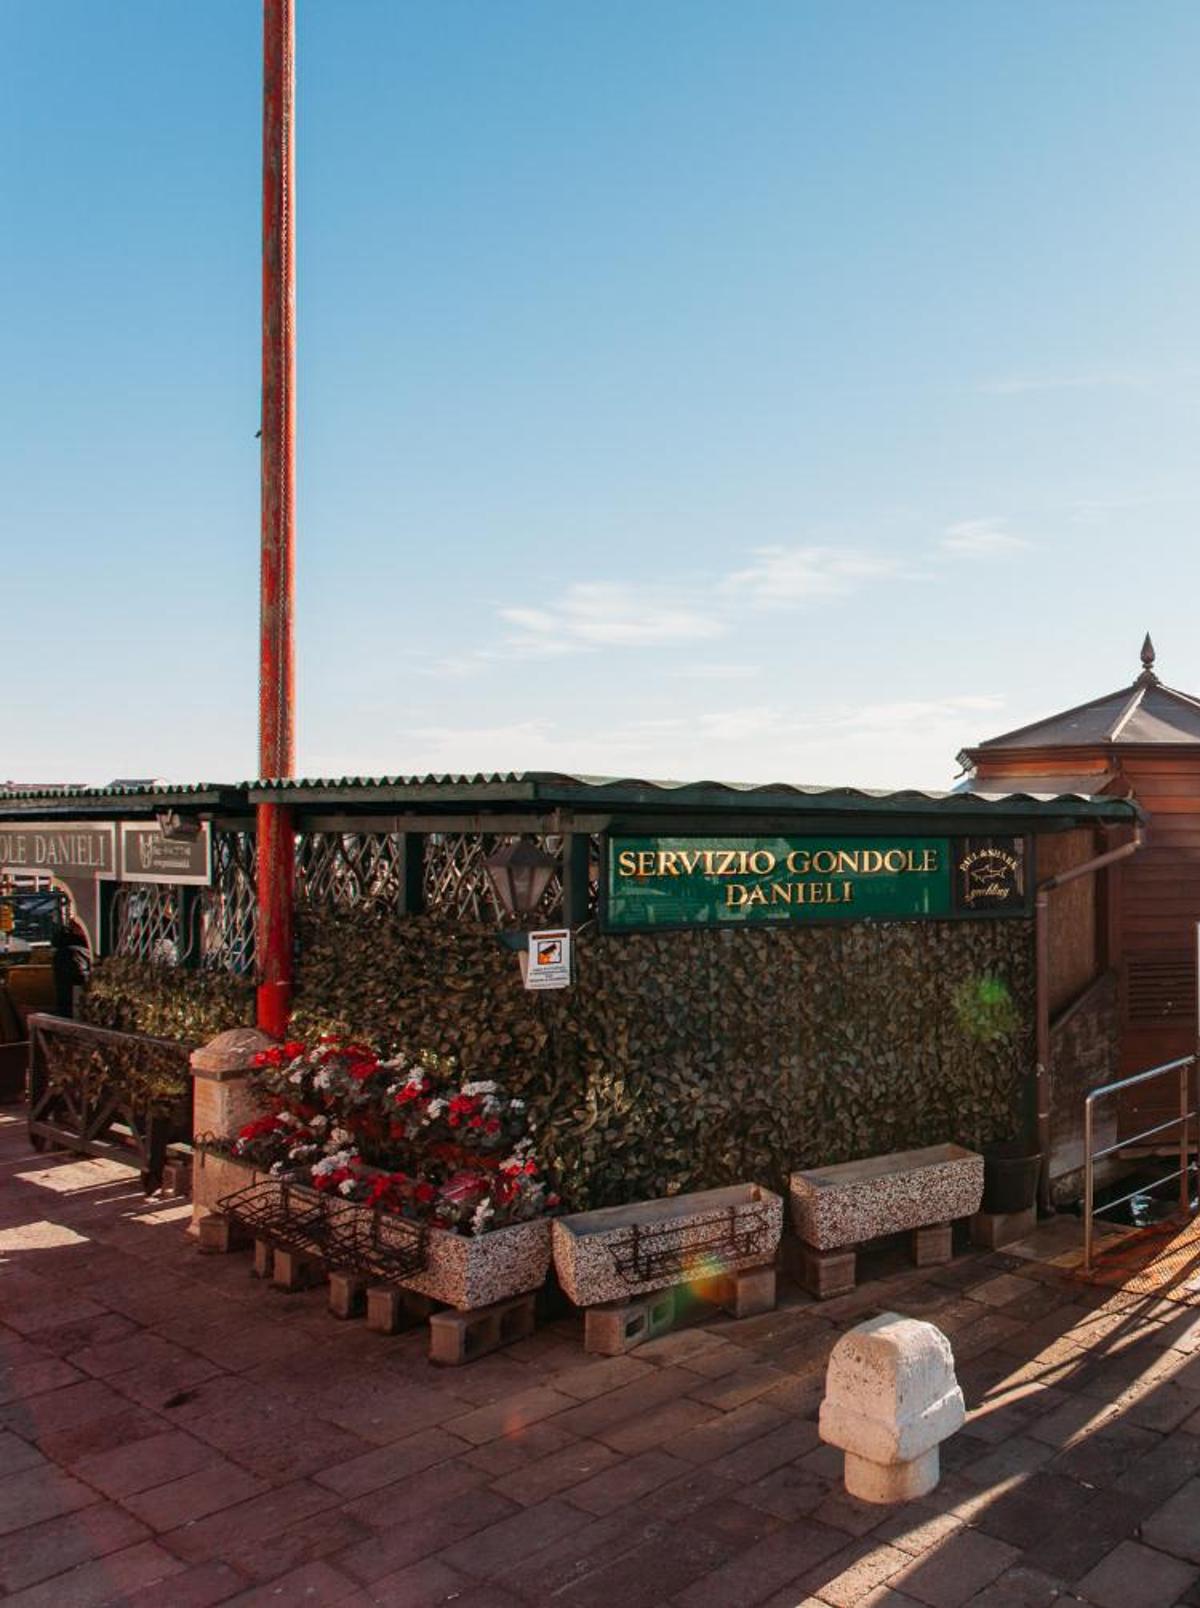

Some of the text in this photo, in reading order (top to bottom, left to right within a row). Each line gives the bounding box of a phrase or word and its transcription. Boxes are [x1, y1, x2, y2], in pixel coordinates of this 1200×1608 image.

[35, 834, 105, 867] DANIELI
[618, 850, 938, 877] SERVIZIO GONDOLE
[726, 882, 854, 907] DANIELI
